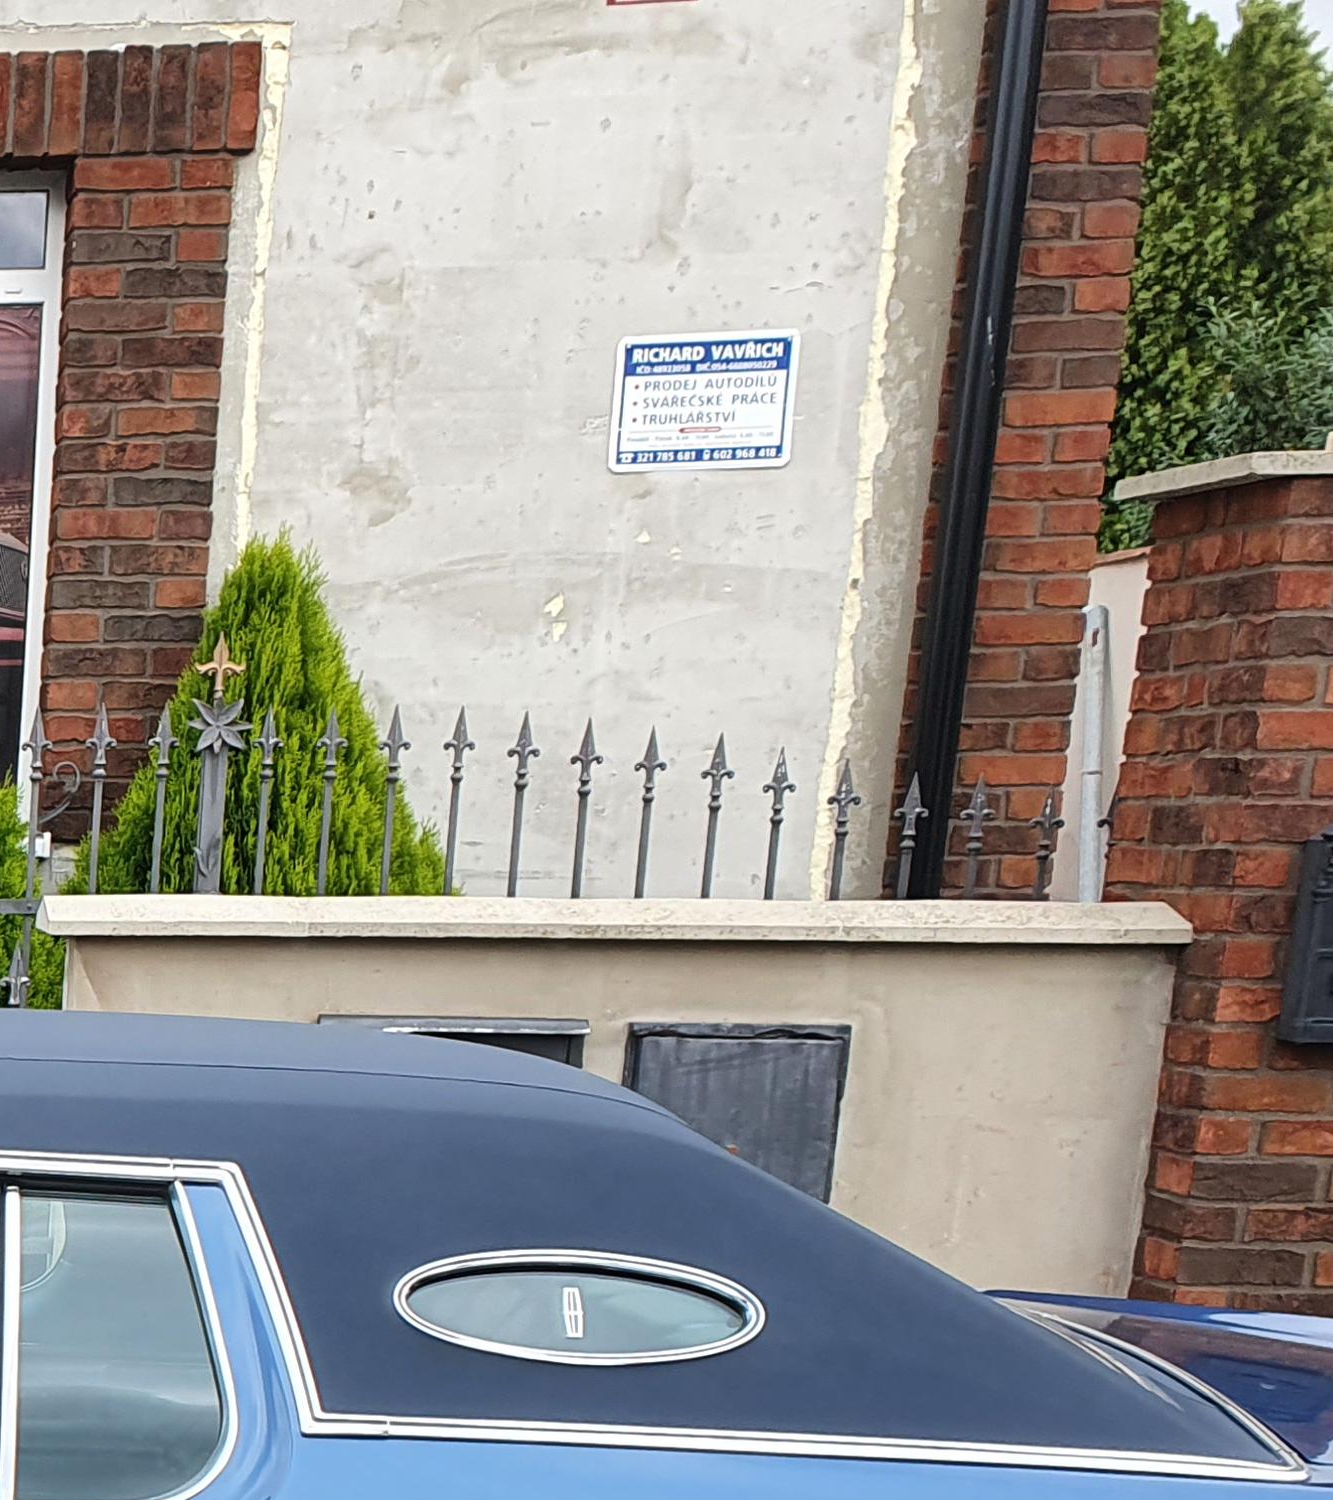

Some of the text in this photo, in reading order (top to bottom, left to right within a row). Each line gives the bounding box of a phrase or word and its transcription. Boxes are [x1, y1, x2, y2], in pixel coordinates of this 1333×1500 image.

[633, 341, 785, 363] RICHARD VAVŘICH
[644, 379, 697, 391] PRODEJ
[731, 391, 777, 405] PRÁCE
